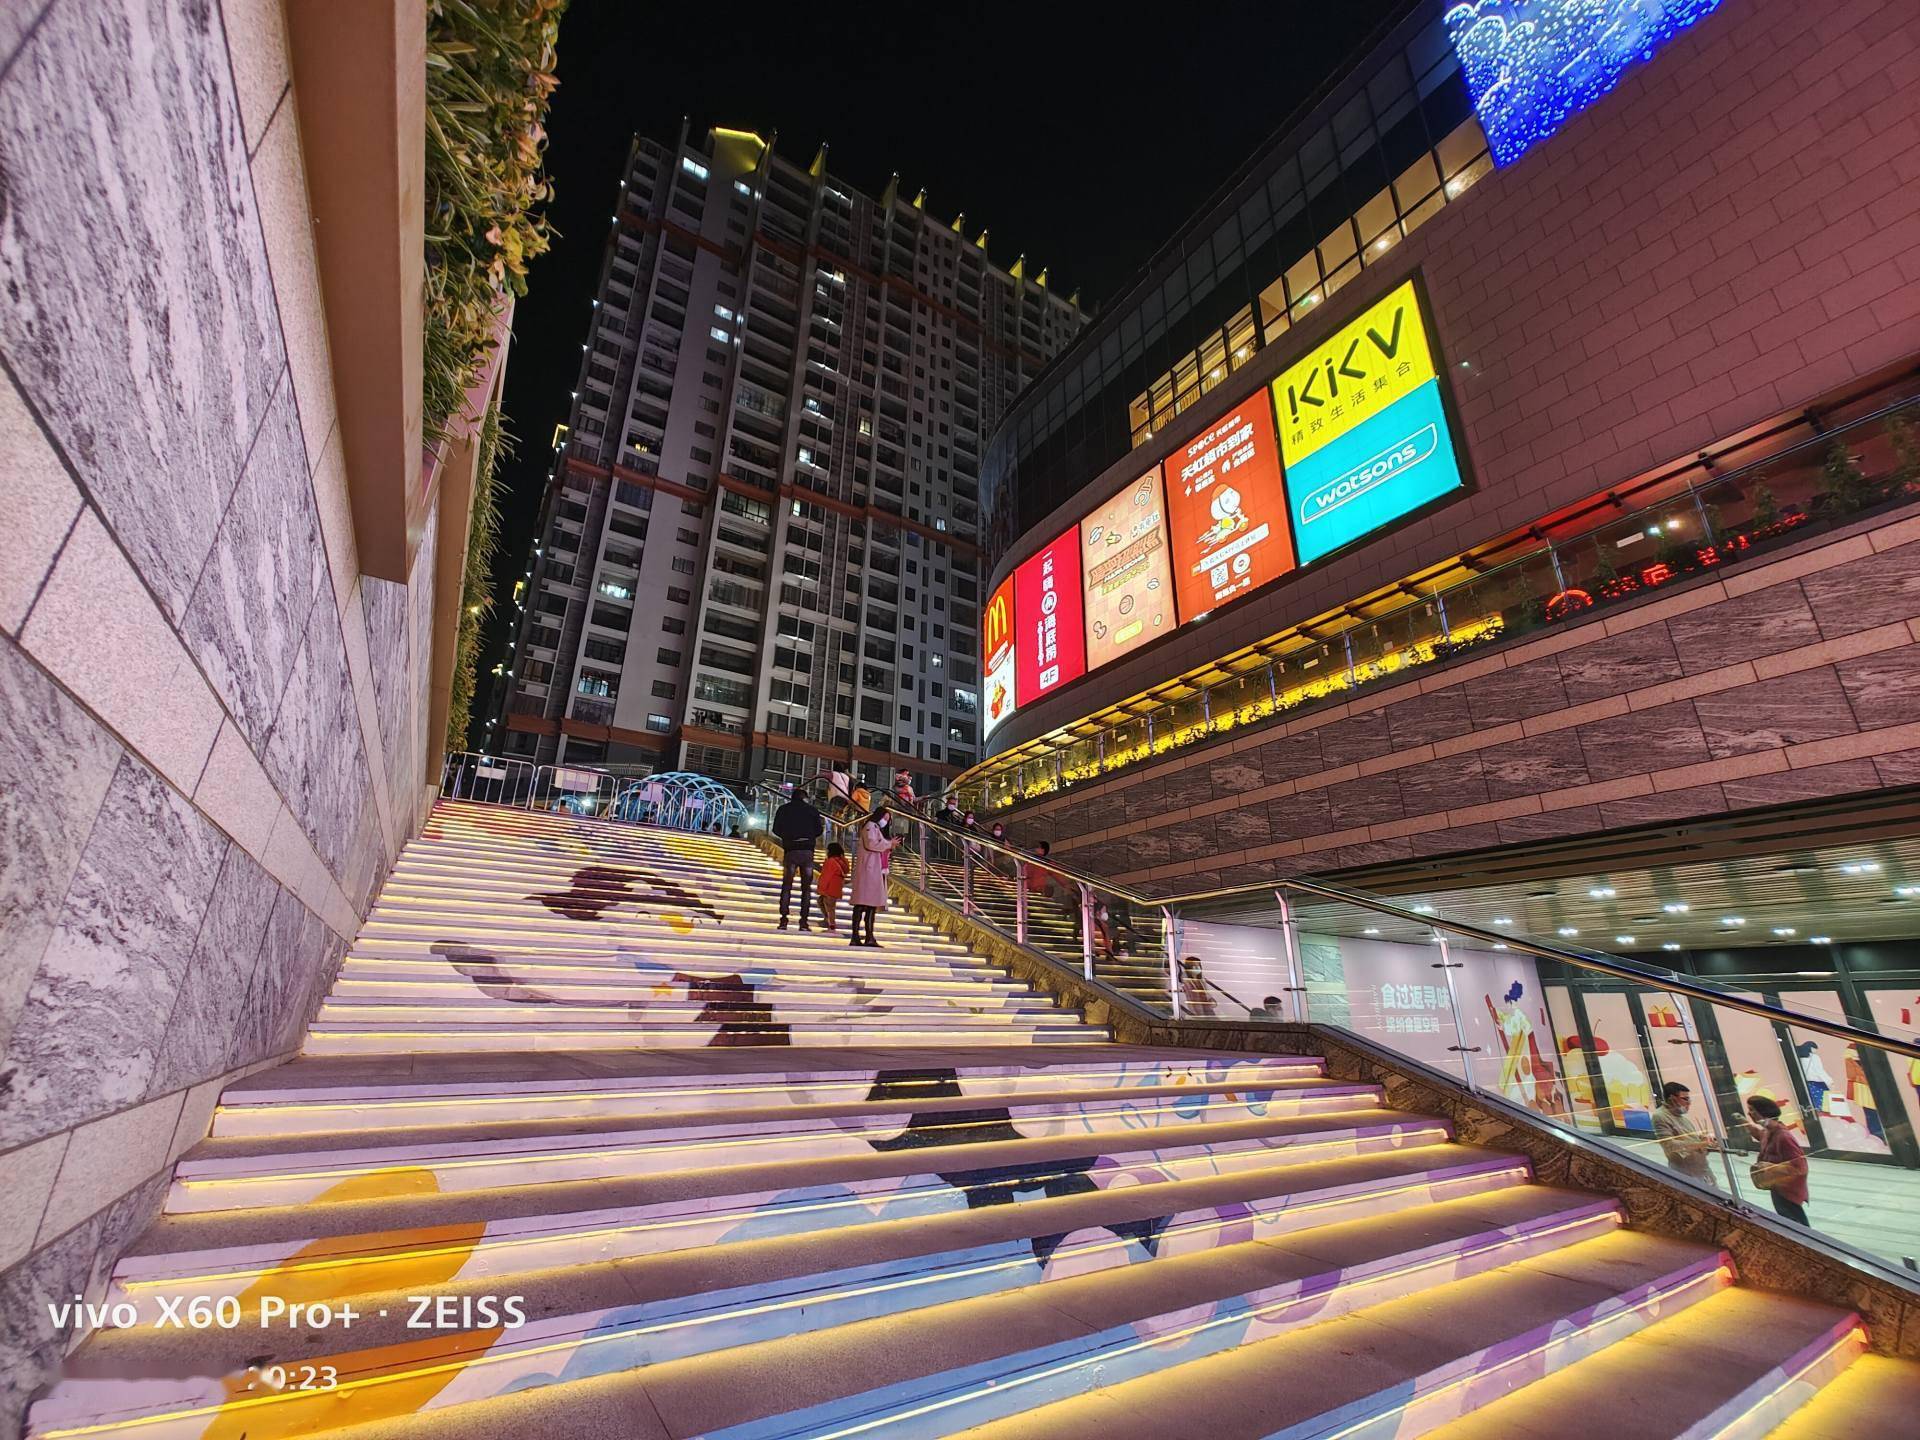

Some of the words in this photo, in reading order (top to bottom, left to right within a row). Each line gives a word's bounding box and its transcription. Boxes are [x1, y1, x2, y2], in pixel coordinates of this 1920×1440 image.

[1291, 359, 1413, 446] 精致生活集合
[1181, 421, 1254, 482] 天虹超市到家
[1316, 442, 1417, 508] watsons
[1042, 669, 1056, 685] 4F
